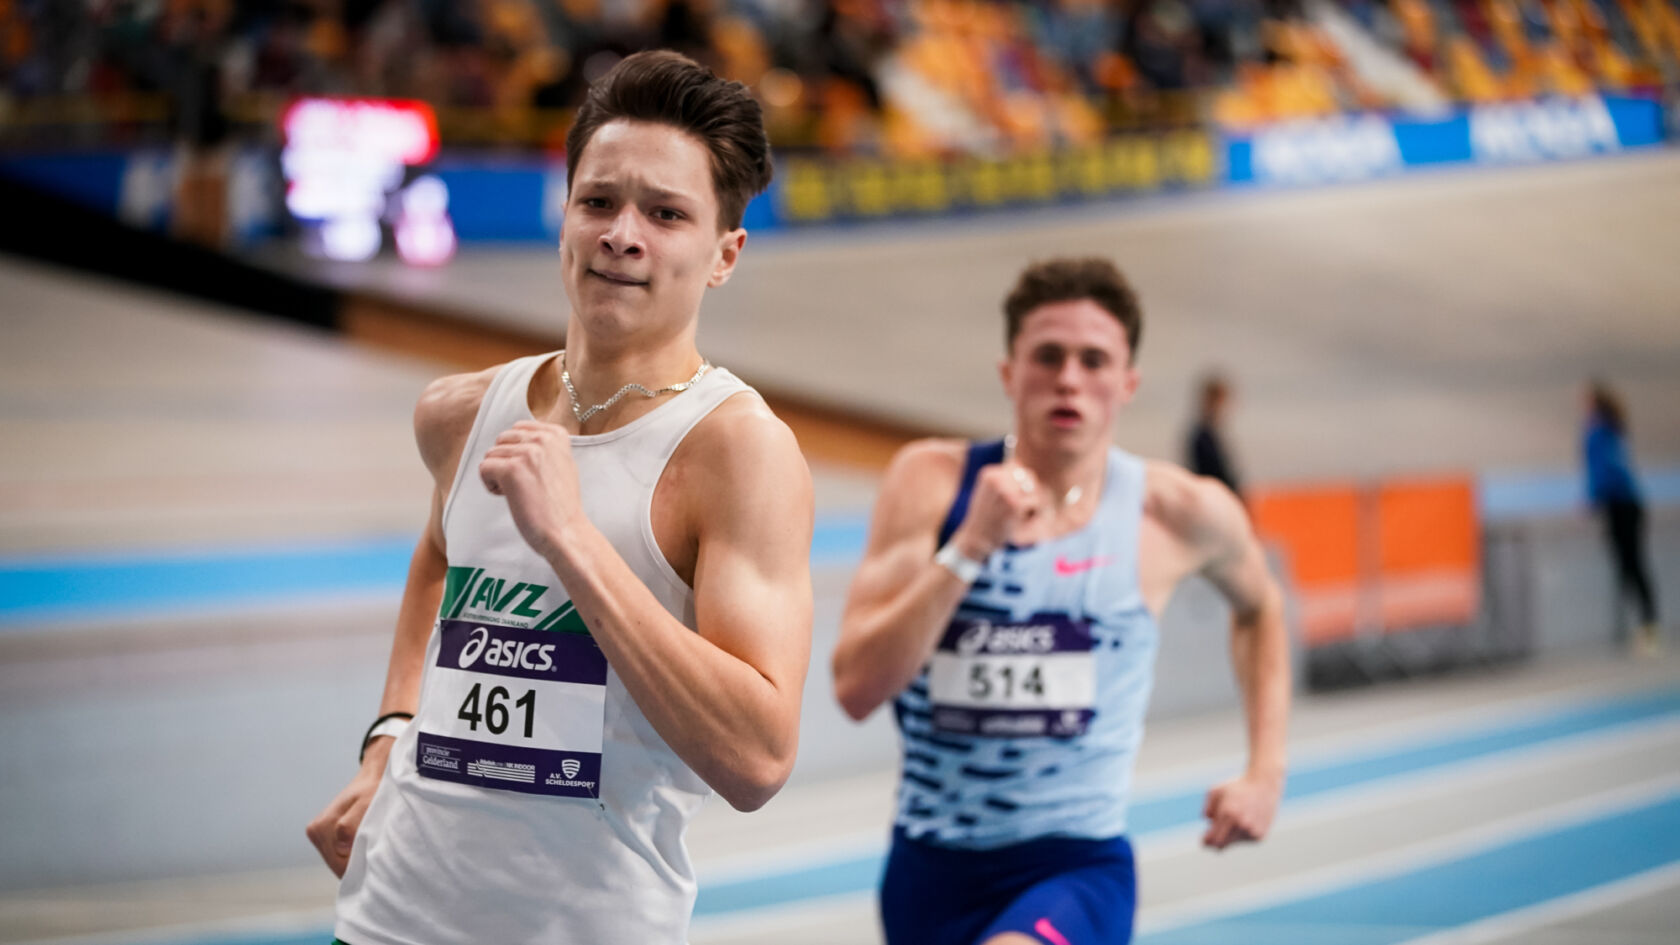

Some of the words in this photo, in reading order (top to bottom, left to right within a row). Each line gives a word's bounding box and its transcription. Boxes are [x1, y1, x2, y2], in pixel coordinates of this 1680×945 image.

[469, 577, 549, 618] AVZ
[967, 664, 1047, 699] 514
[457, 682, 537, 739] 461
[422, 757, 458, 770] Gelderland
[545, 778, 596, 788] SCHELDESPORT
